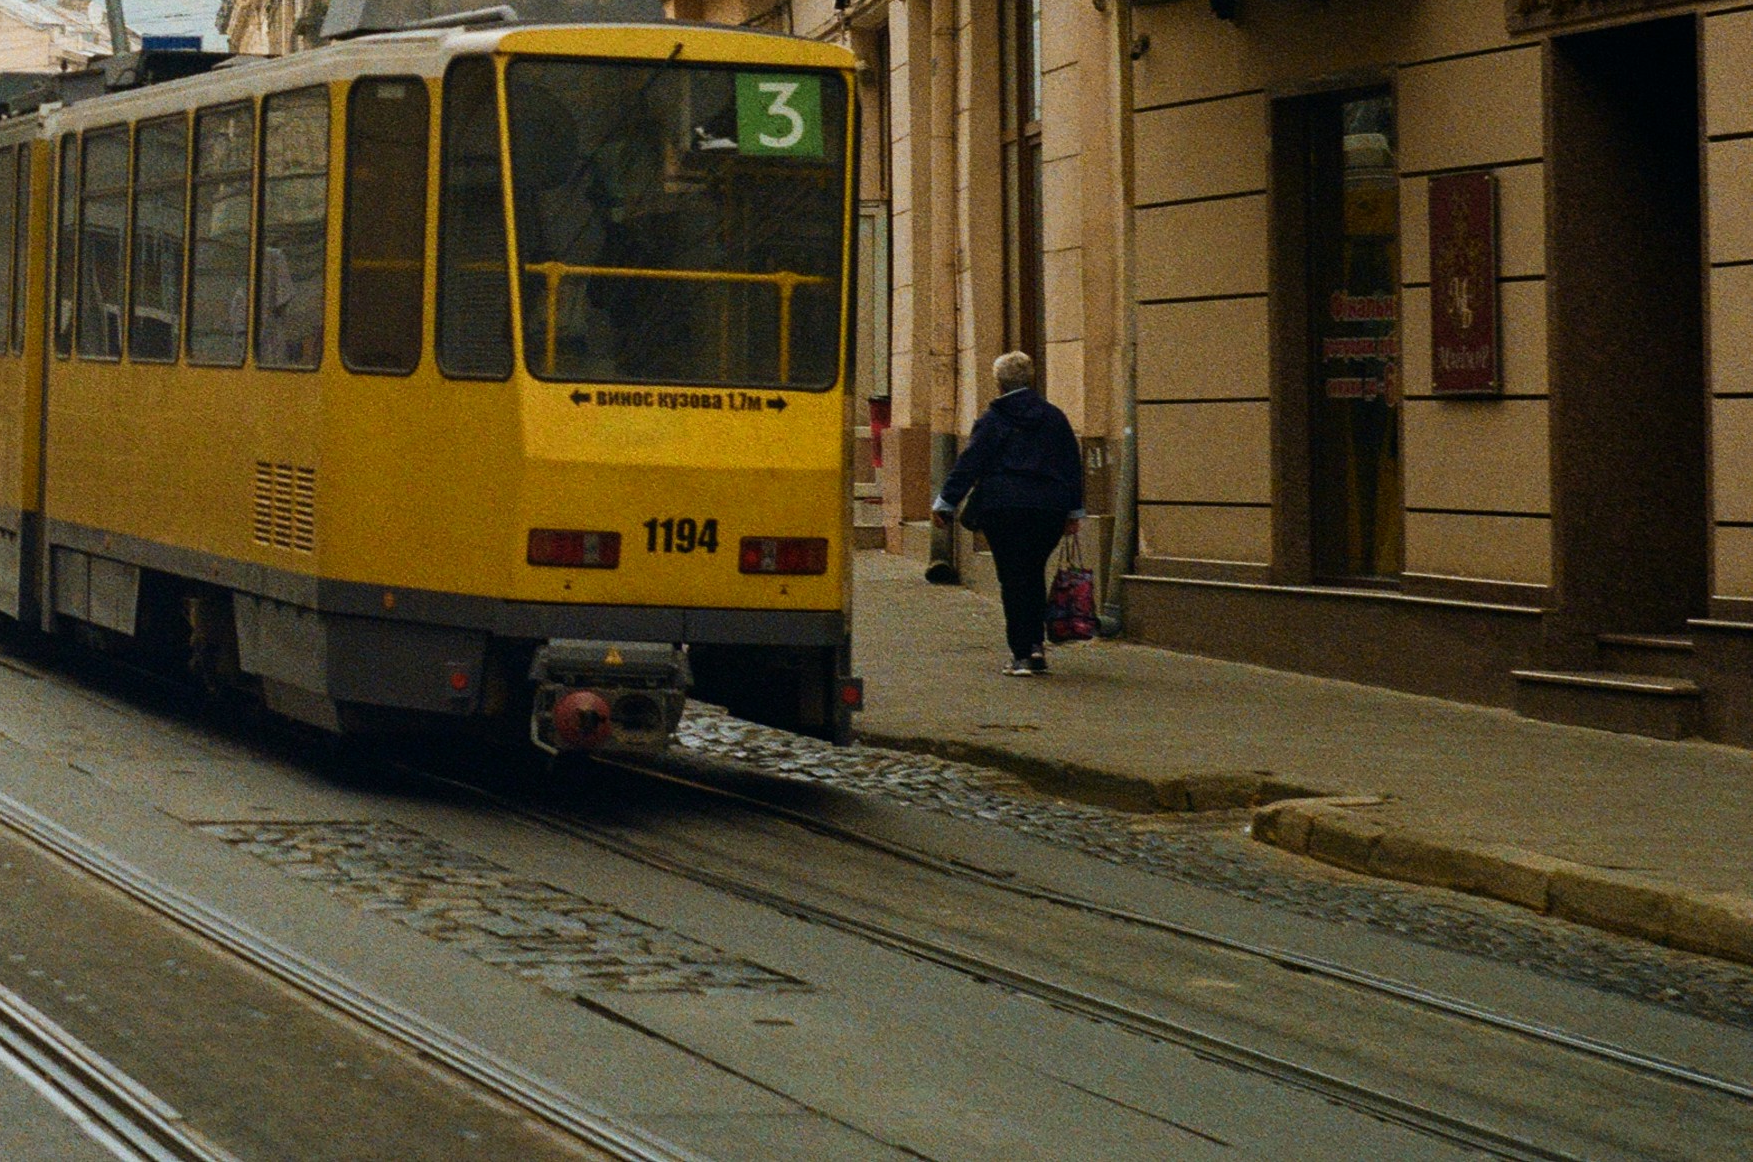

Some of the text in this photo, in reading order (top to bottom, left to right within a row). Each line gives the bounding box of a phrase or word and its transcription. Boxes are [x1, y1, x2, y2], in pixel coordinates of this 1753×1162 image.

[758, 82, 805, 148] 3
[658, 392, 722, 410] кузова
[643, 518, 719, 553] 1194
